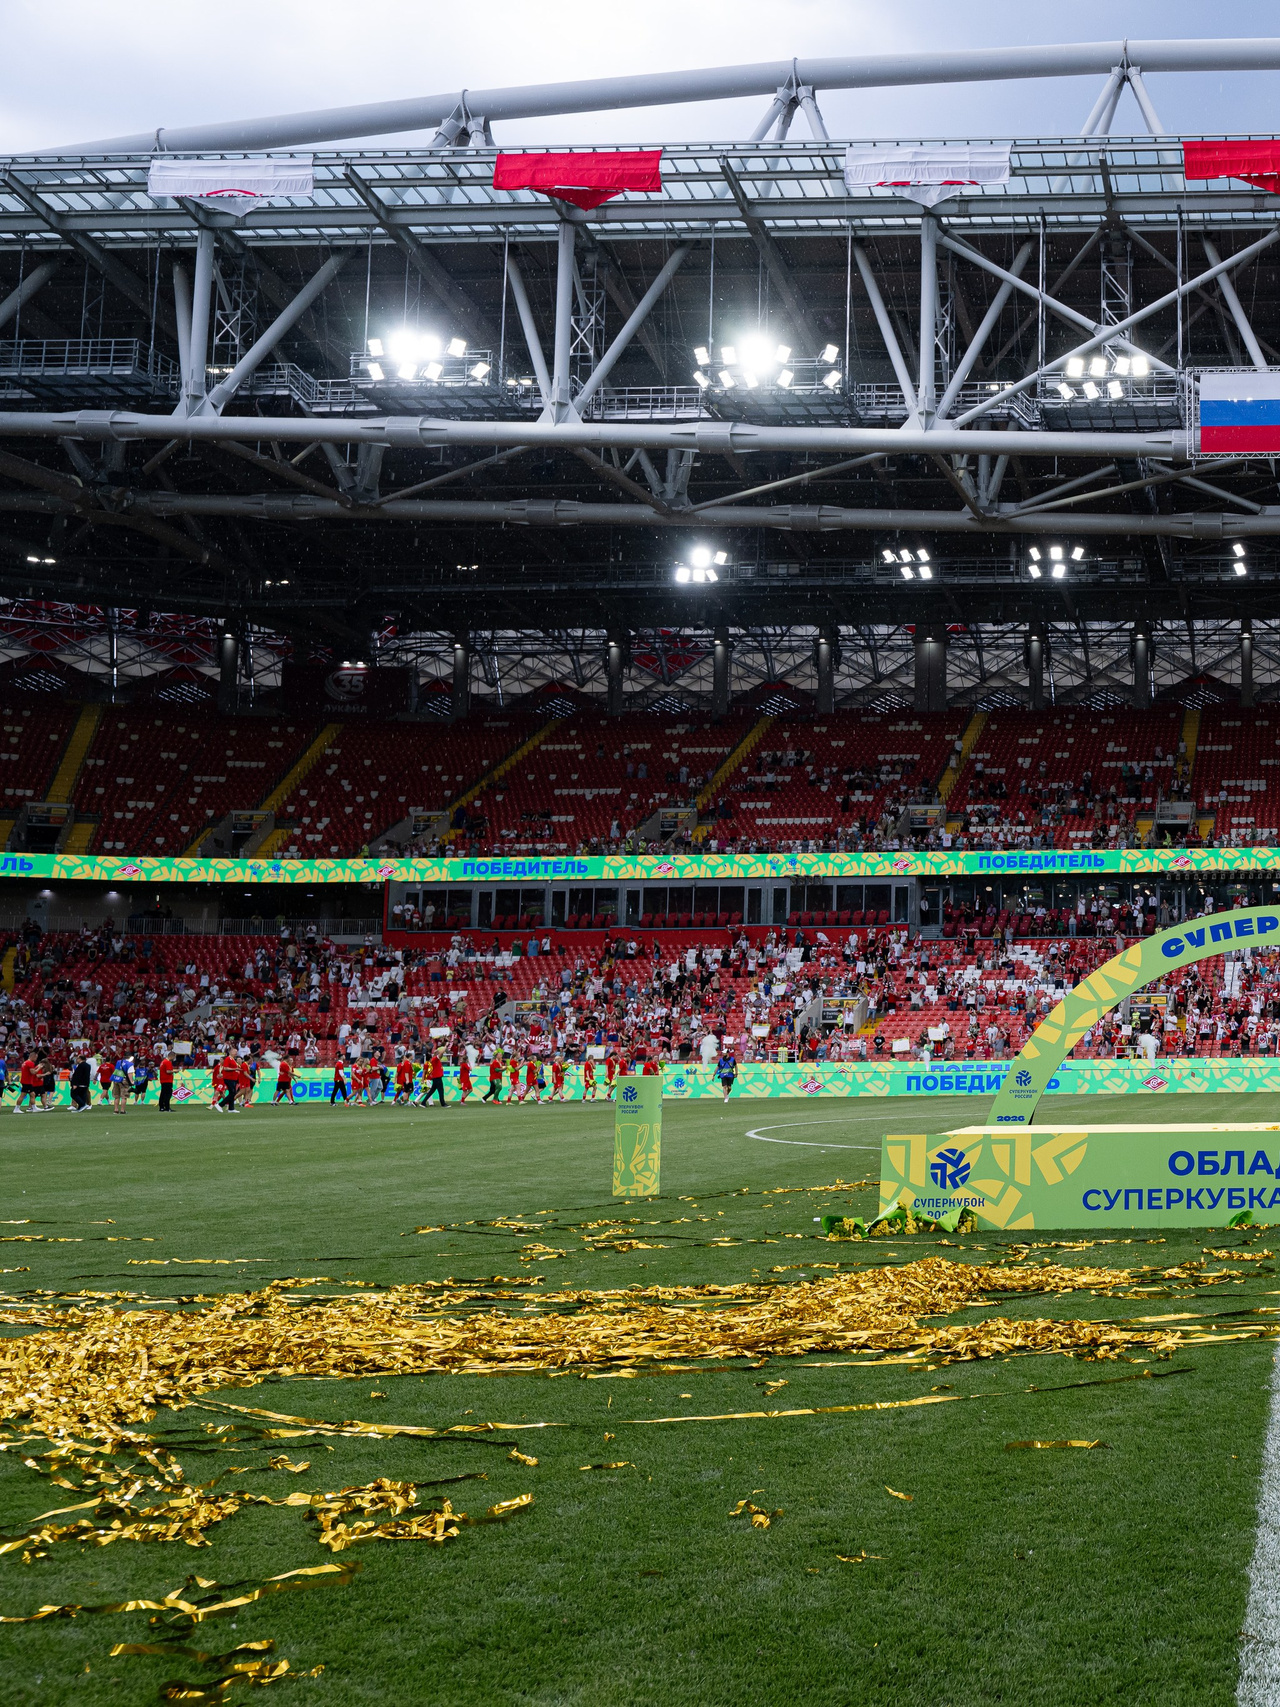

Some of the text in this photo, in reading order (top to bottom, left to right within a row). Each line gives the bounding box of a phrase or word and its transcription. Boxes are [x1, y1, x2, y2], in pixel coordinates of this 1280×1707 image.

[338, 675, 365, 693] 35
[463, 861, 589, 877] ПОБЕДИТЕЛЬ
[978, 854, 1105, 870] ПОБЕДИТЕЛЬ
[906, 1074, 1061, 1093] ПОБЕДИЬ
[913, 1197, 985, 1208] СУПЕРКУБОК
